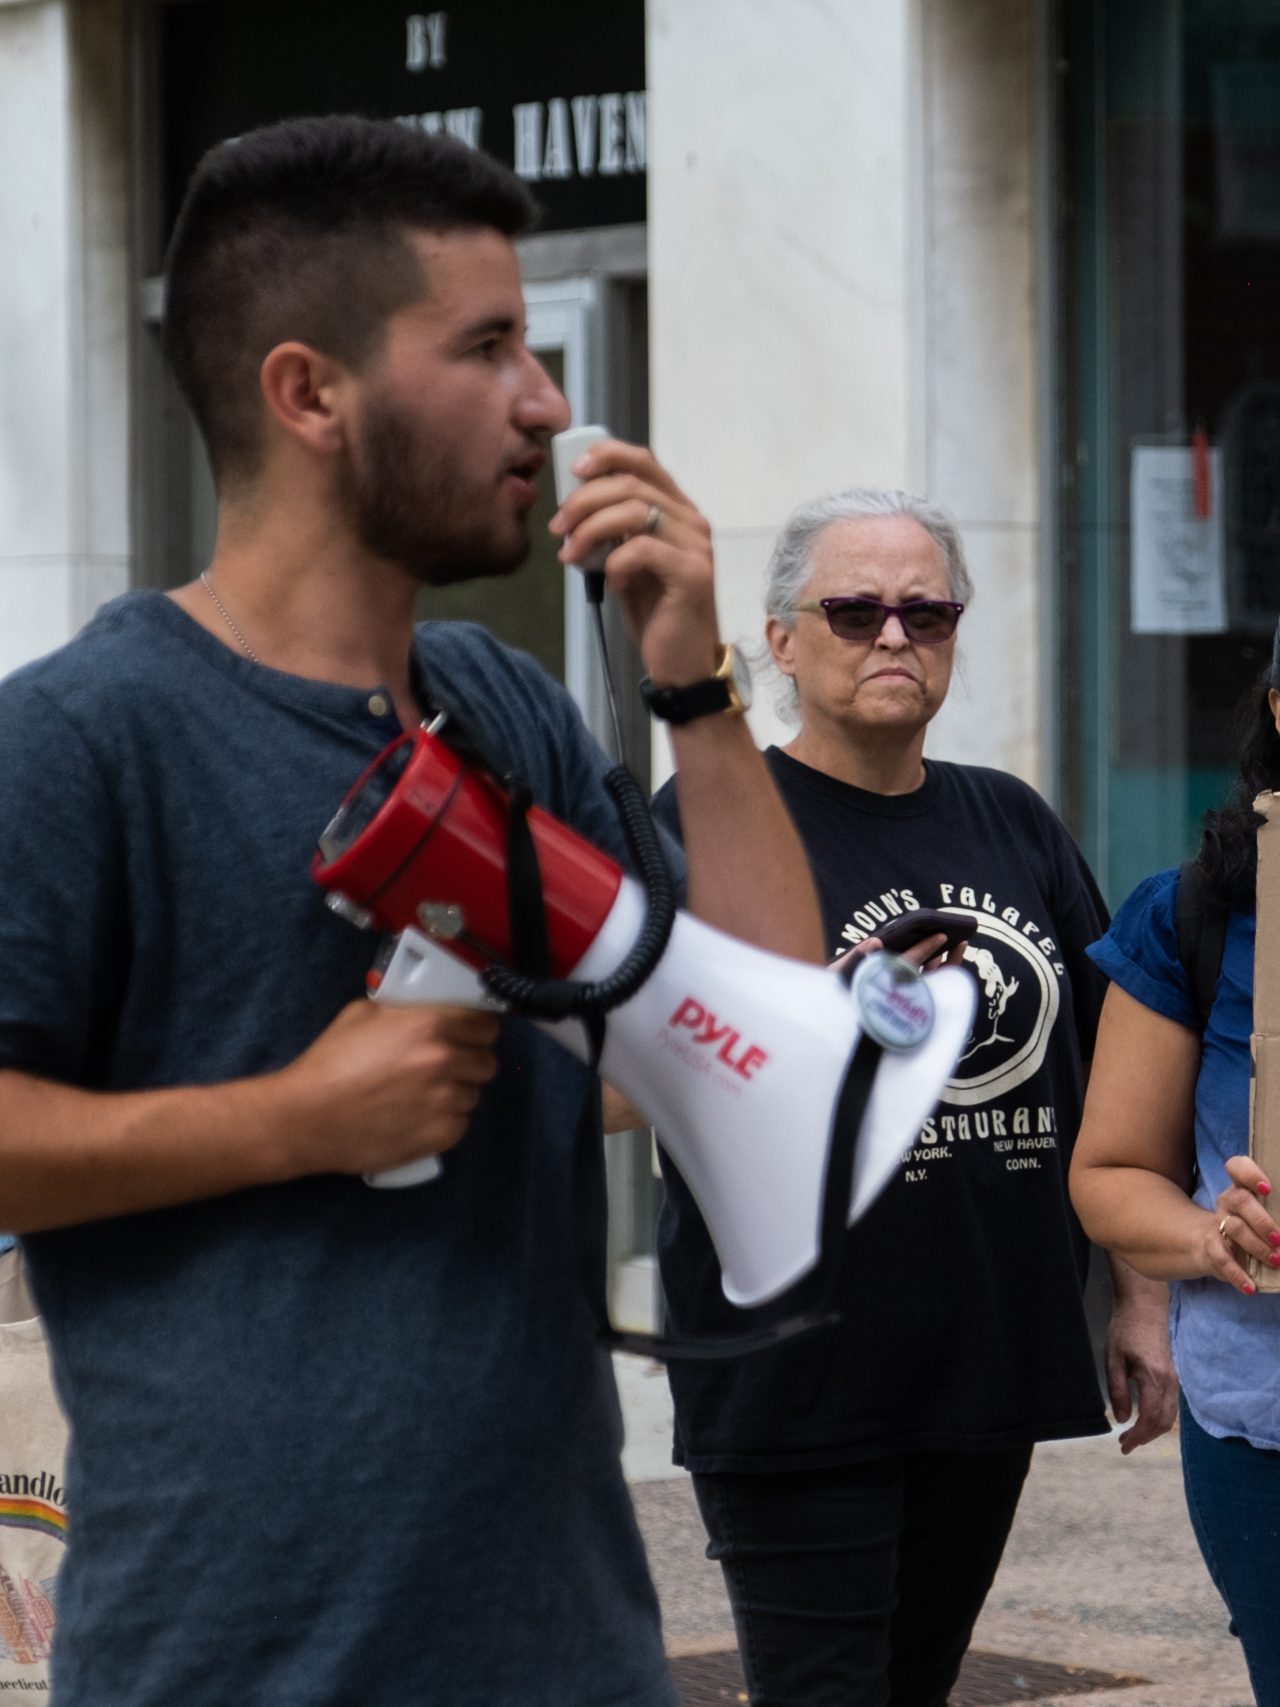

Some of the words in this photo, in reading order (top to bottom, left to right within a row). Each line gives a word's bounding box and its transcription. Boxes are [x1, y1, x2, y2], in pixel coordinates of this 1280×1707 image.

[405, 11, 447, 72] BY
[513, 91, 648, 181] HAVEN
[835, 888, 921, 956] MOUN'S
[920, 1106, 1058, 1145] STAURAN
[913, 1146, 953, 1162] YORK.
[993, 1139, 1014, 1153] NEW
[905, 1168, 928, 1183] N.Y.
[1005, 1157, 1042, 1171] CONN.
